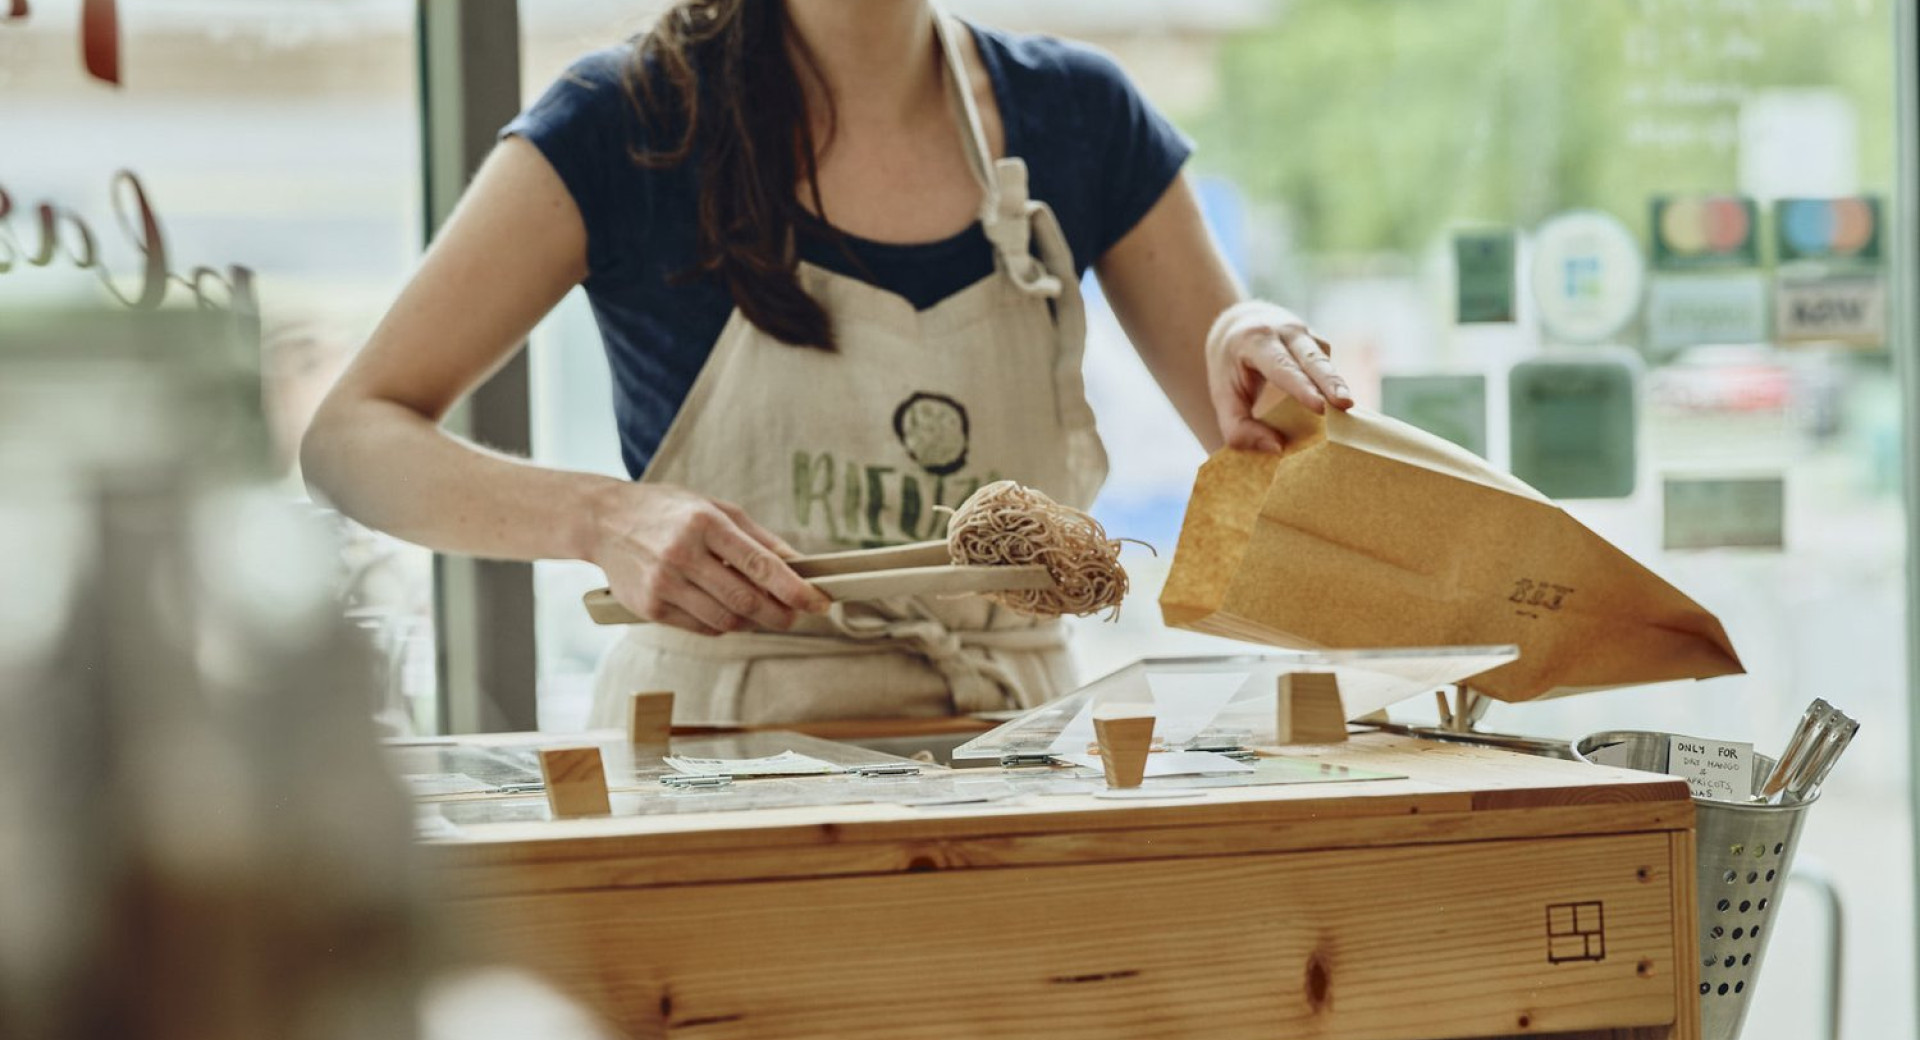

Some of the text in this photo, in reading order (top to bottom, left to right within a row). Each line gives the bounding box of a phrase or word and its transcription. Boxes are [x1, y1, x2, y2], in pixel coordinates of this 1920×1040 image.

[1678, 743, 1738, 759] ONLY FOR
[1707, 760, 1740, 770] MANGO
